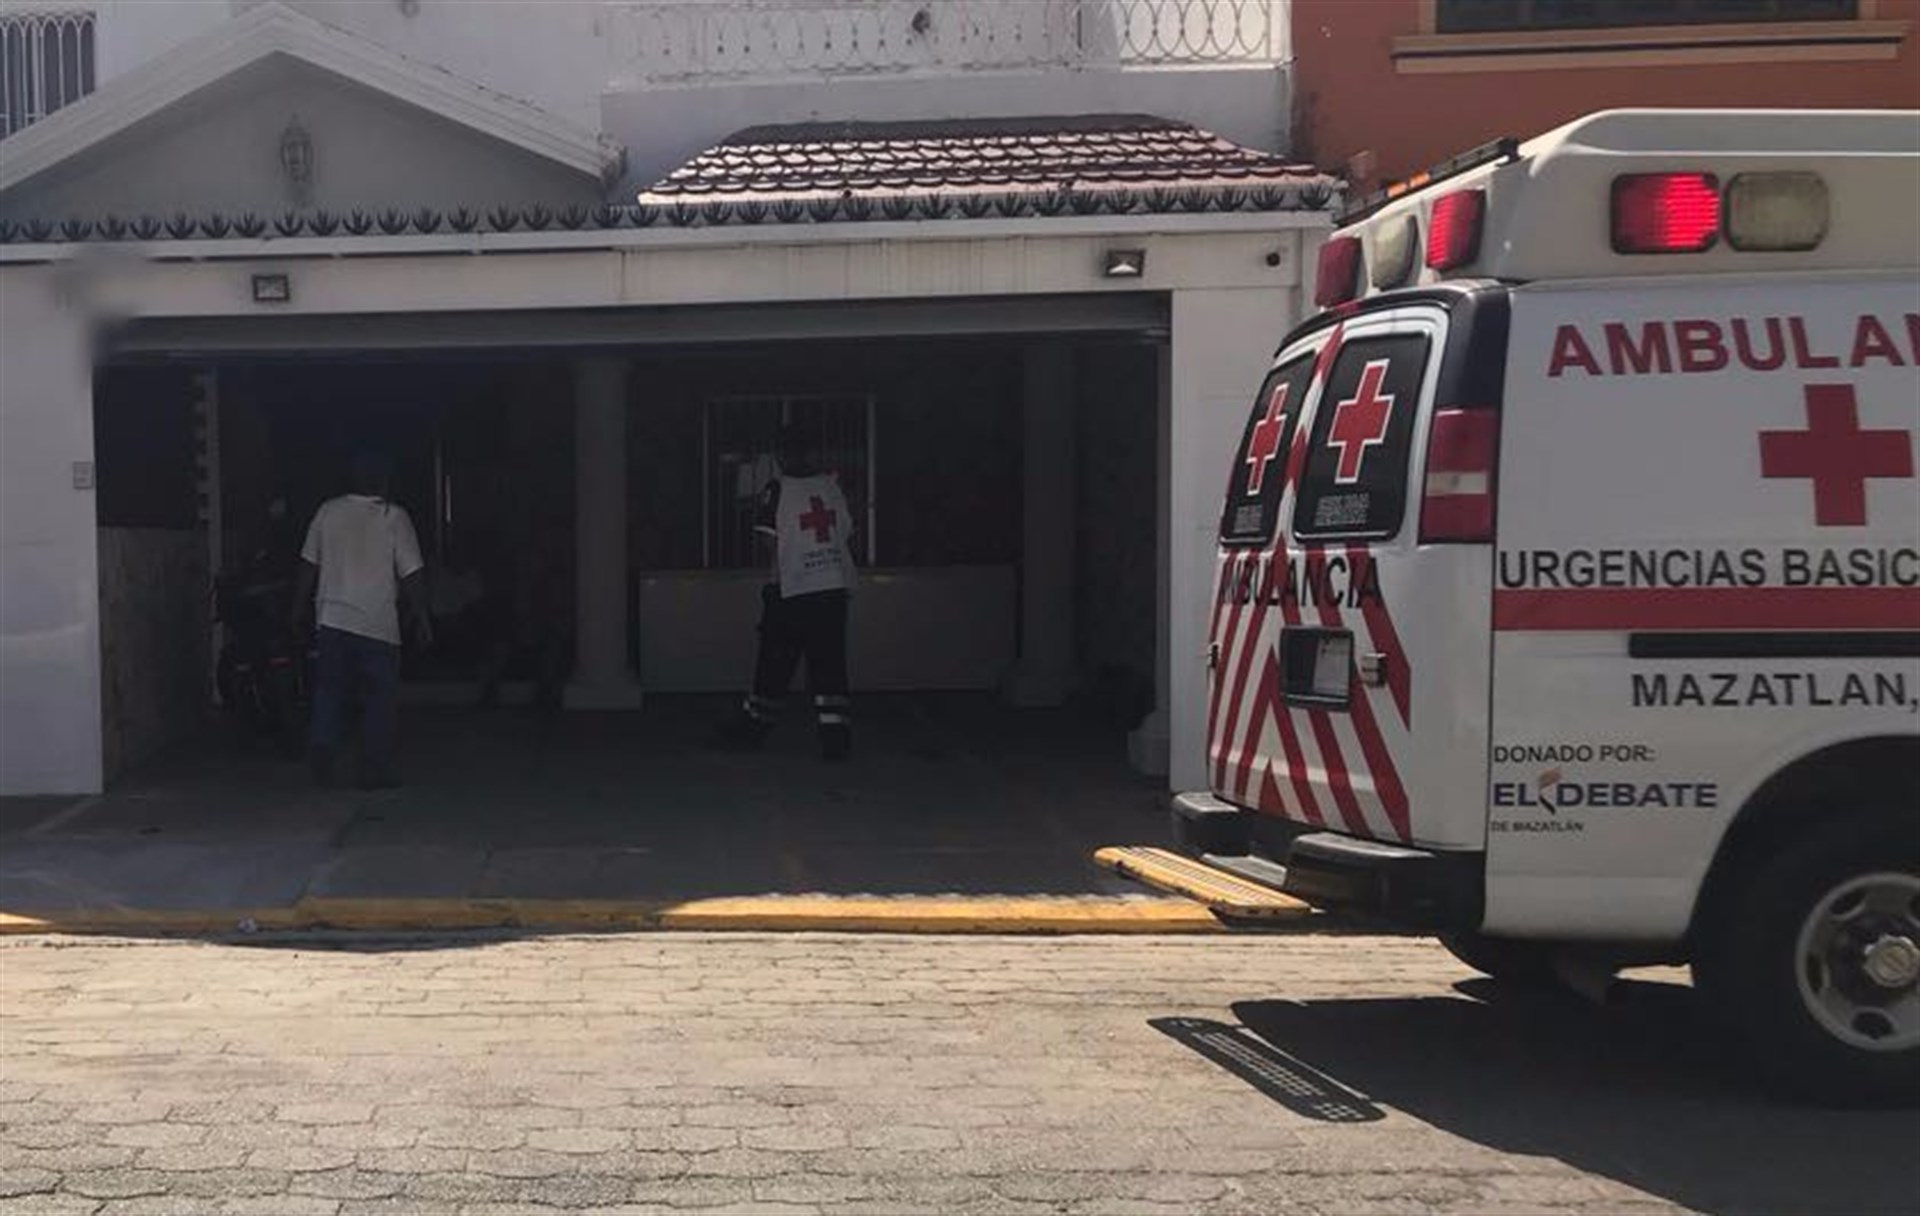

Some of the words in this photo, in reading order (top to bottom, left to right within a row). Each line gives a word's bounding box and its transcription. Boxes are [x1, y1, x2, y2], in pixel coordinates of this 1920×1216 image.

[1547, 313, 1920, 377] AMBULA
[1500, 549, 1767, 588] URGENCIAS
[1782, 548, 1920, 587] BASIC
[1631, 673, 1919, 713] MAZATLAN,
[1493, 746, 1593, 763] DONADO
[1600, 745, 1655, 763] POR:
[1493, 783, 1538, 807] EL
[1556, 783, 1718, 808] DEBATE
[1490, 821, 1509, 833] DE
